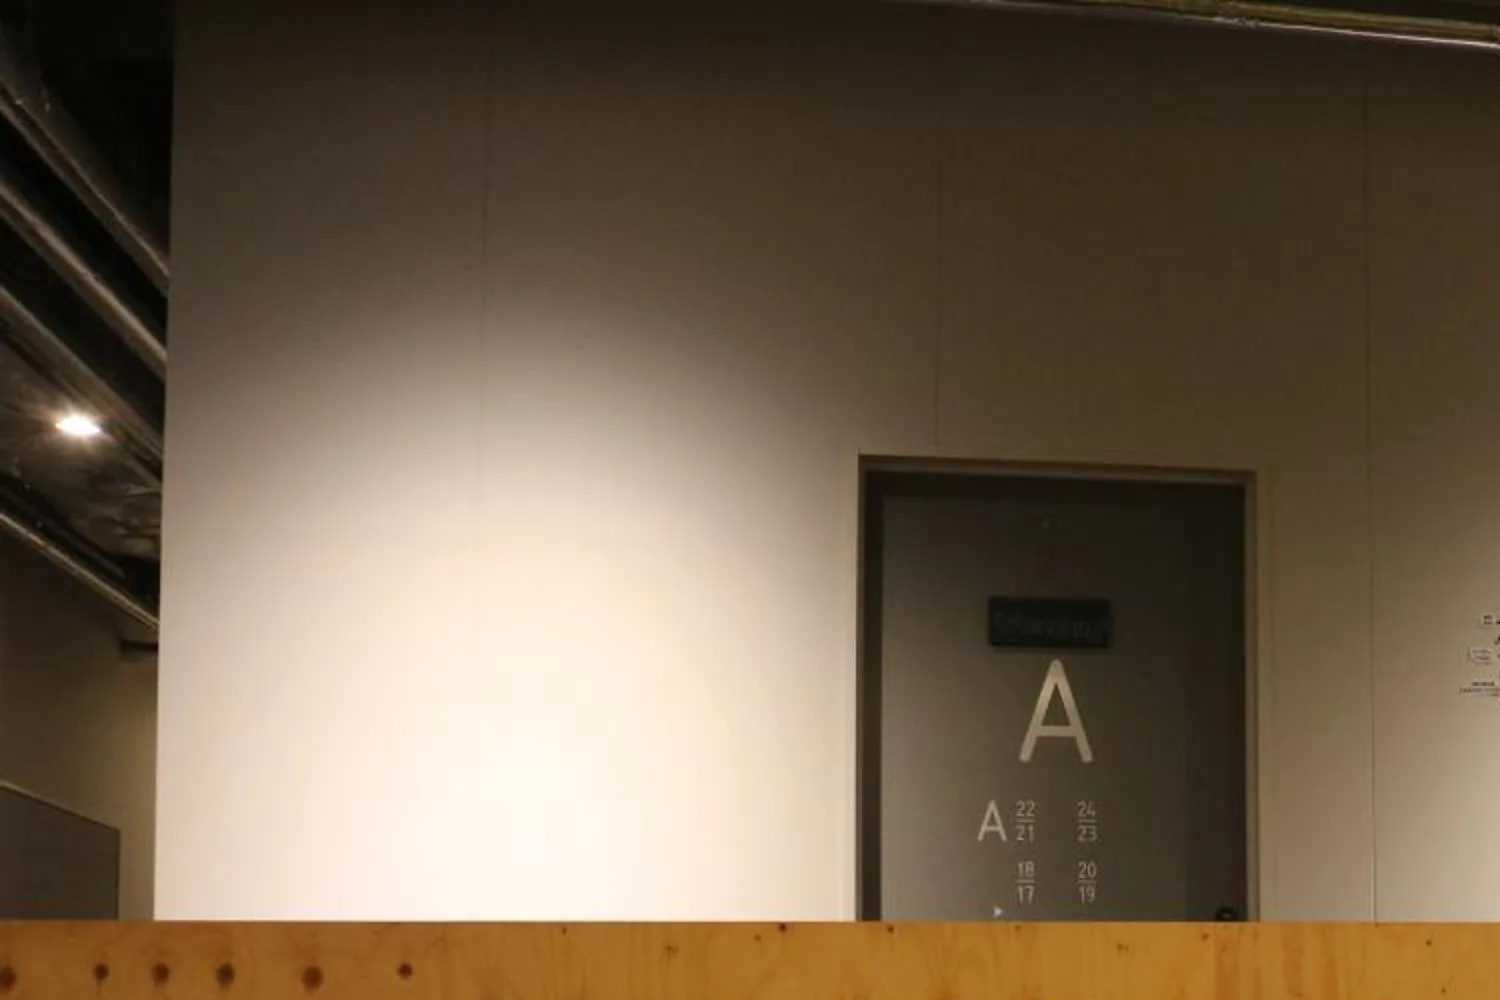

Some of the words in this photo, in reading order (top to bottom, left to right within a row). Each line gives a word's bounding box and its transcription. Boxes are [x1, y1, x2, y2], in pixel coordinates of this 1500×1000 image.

[1018, 658, 1095, 764] A
[977, 800, 1008, 843] A
[1015, 801, 1036, 818] 22
[1076, 801, 1097, 818] 24
[1015, 825, 1036, 842] 21
